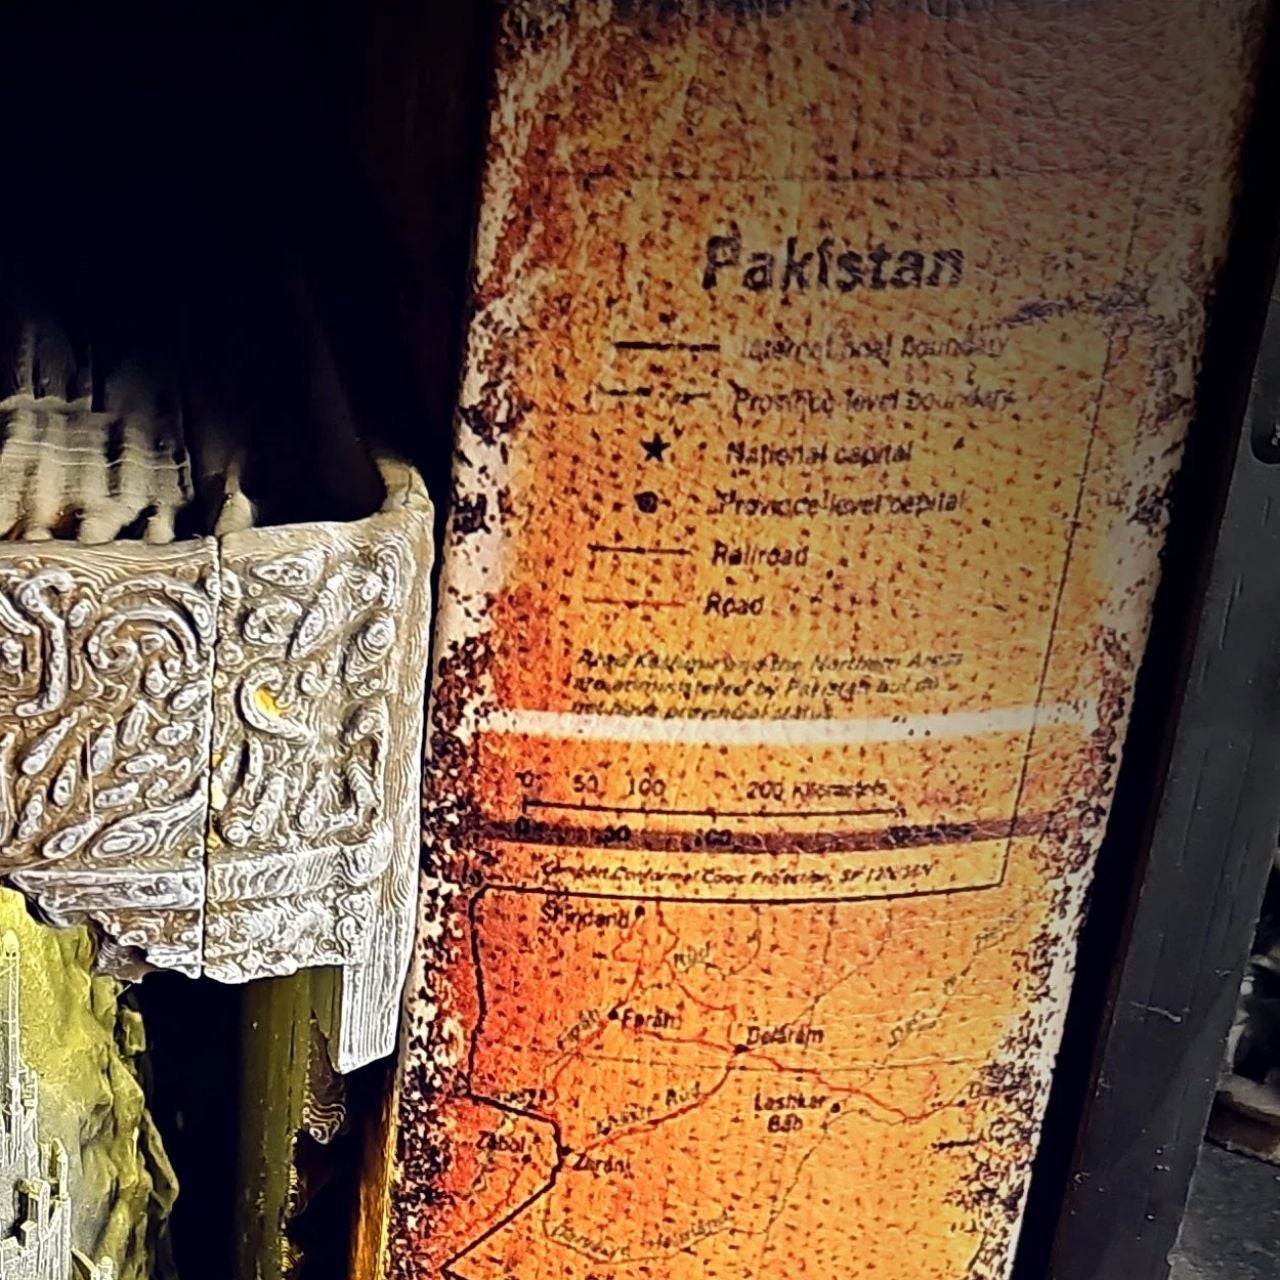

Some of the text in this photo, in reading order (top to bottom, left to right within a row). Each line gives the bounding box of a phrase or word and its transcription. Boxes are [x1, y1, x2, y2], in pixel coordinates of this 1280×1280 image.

[702, 233, 964, 292] Pakistan
[712, 541, 808, 567] Railroad
[703, 596, 763, 617] Road
[573, 774, 600, 794] 50
[628, 777, 666, 797] 100
[746, 781, 783, 800] 200
